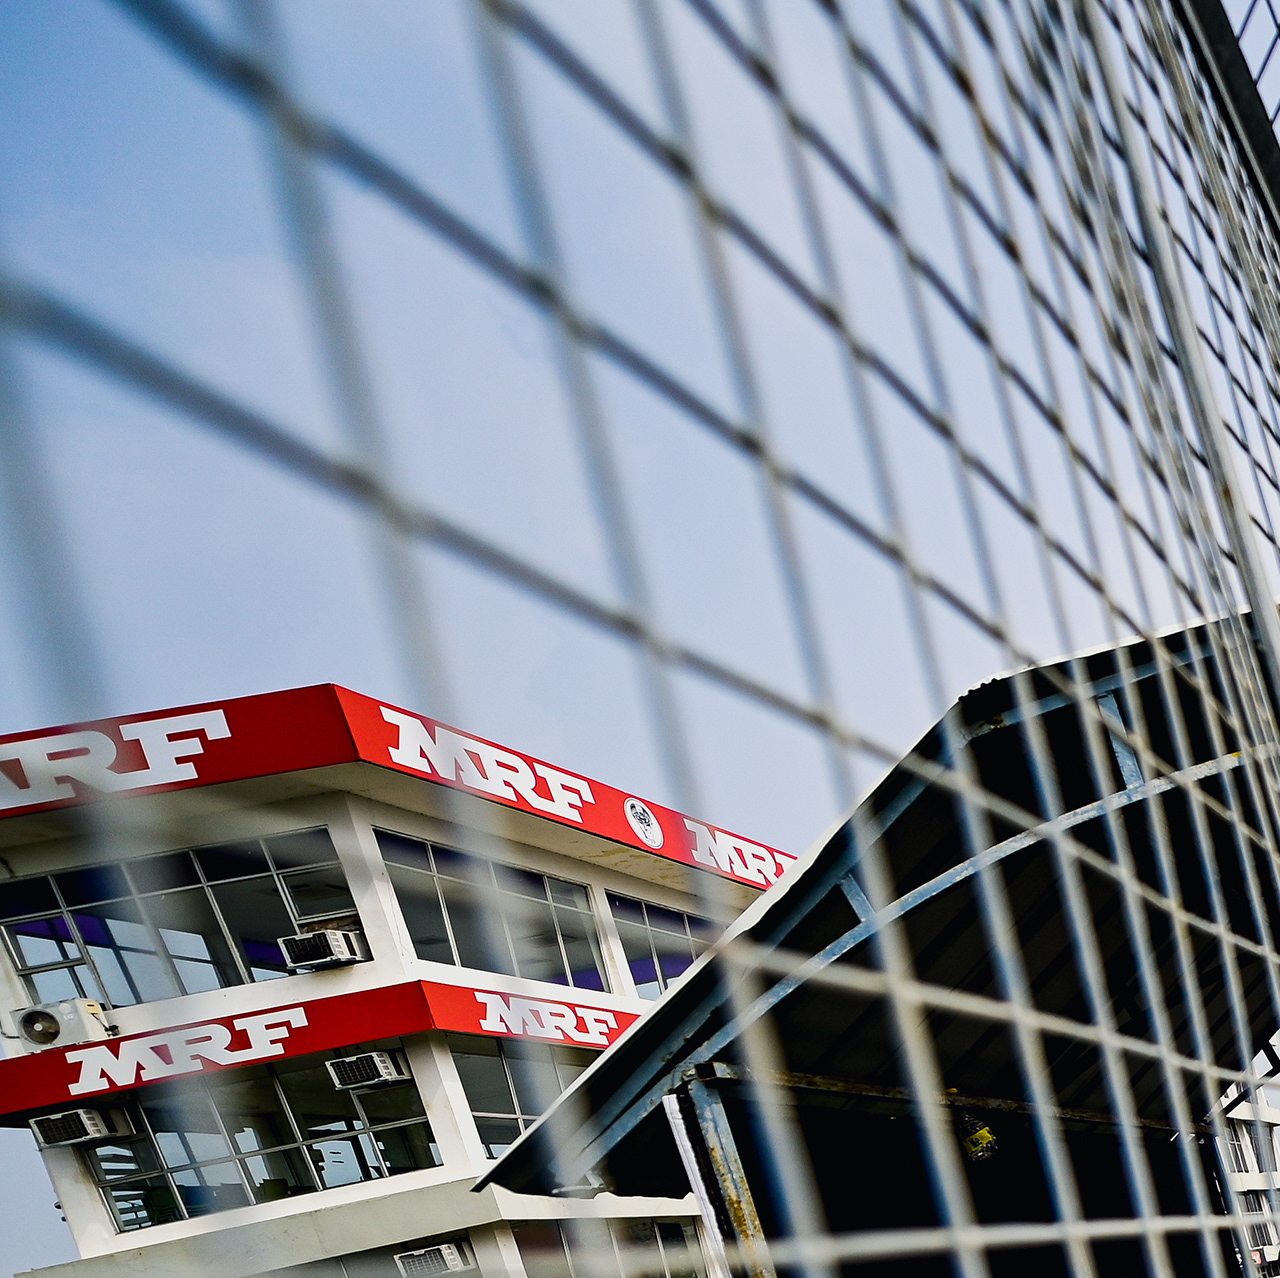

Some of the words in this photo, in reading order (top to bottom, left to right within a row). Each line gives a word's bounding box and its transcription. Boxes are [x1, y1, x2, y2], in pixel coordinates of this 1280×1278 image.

[0, 709, 231, 810] RF
[379, 705, 596, 823] MRF
[65, 1007, 309, 1095] MRF
[476, 991, 619, 1045] MRF
